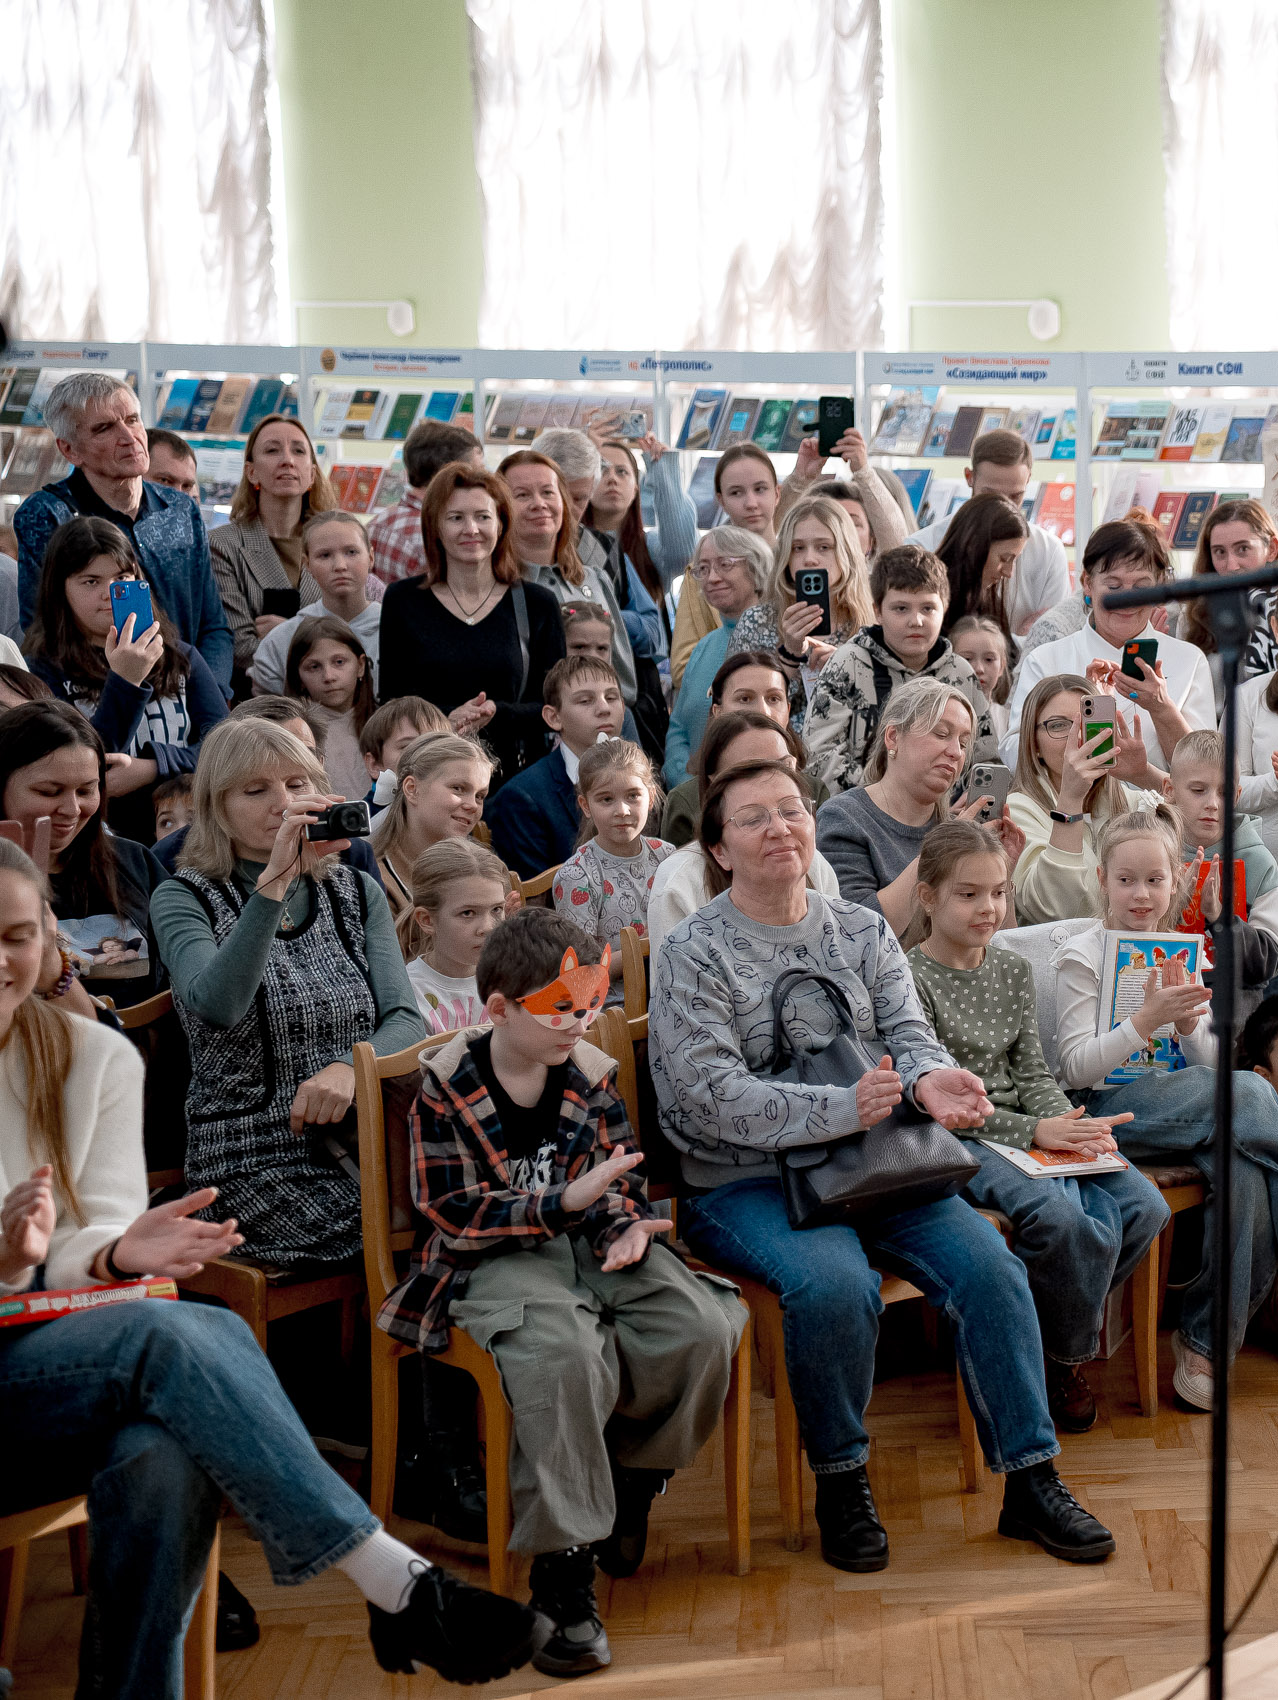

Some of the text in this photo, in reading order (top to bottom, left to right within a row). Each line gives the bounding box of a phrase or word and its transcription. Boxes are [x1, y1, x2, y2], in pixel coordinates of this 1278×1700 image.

[946, 367, 1048, 382] «Созидающий мир»
[1178, 361, 1243, 375] Книги СФИ
